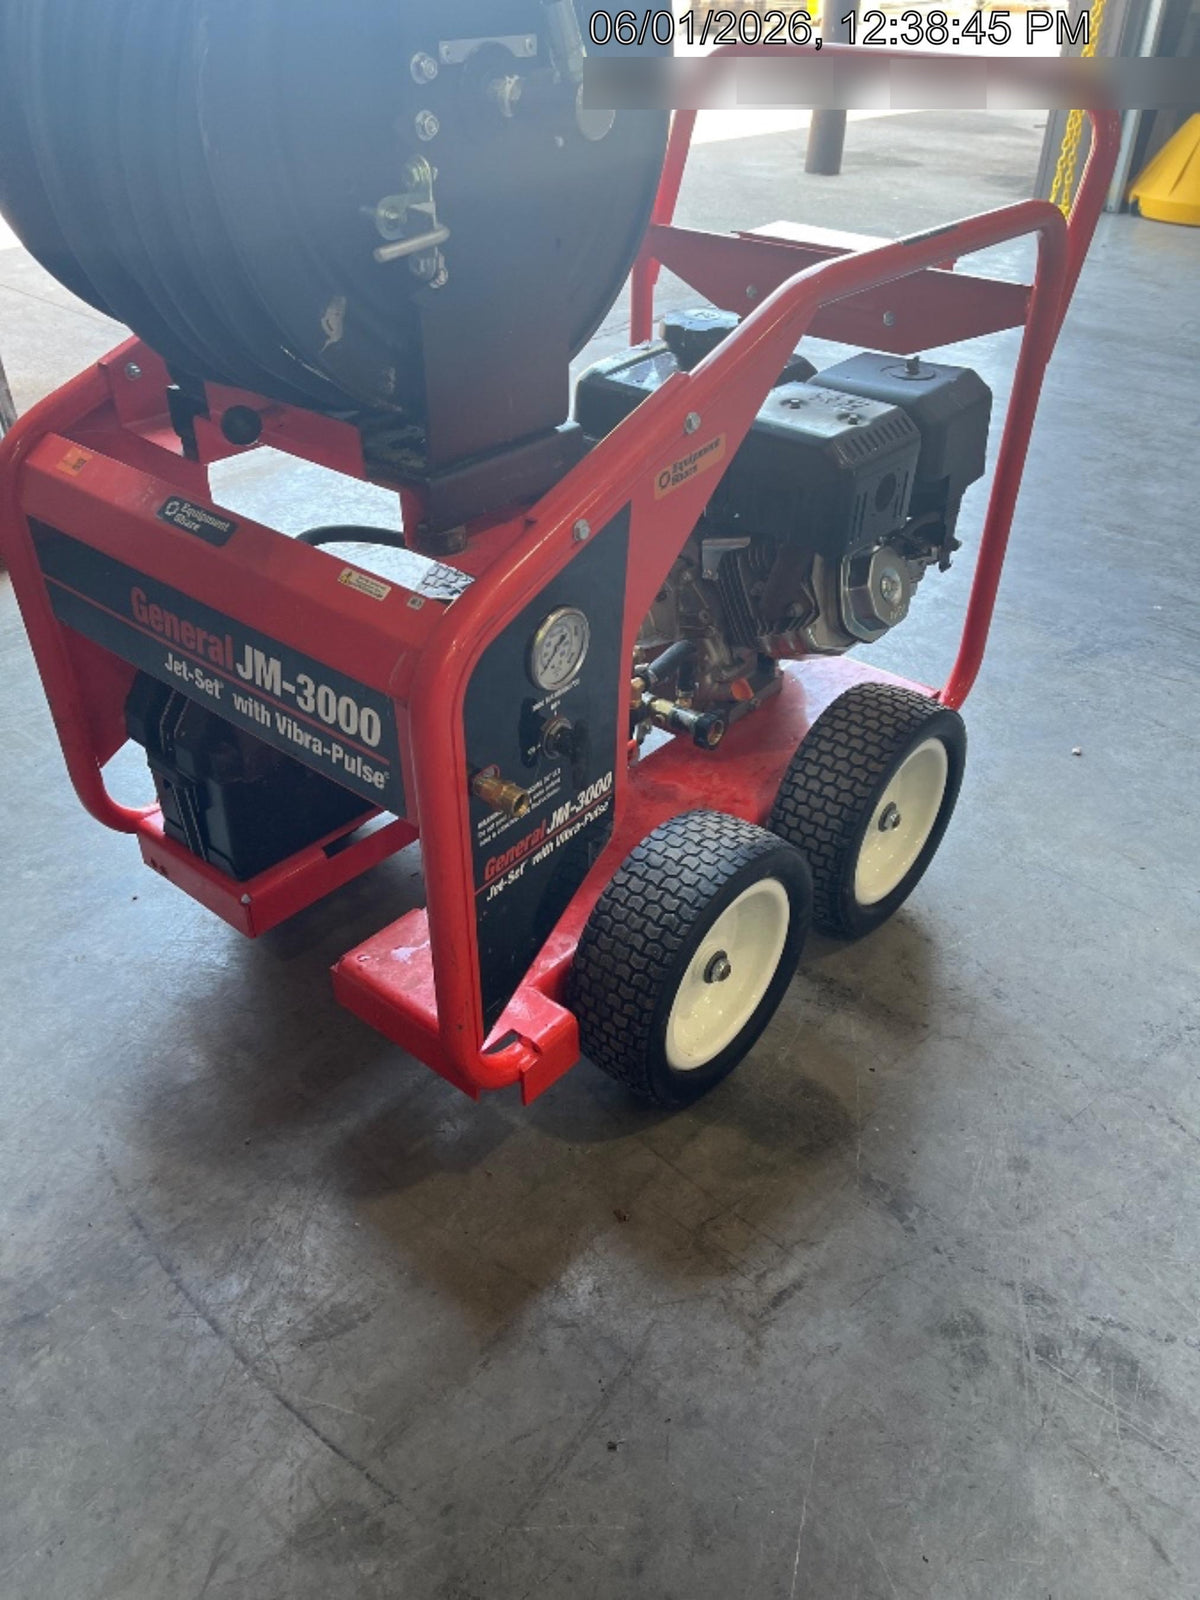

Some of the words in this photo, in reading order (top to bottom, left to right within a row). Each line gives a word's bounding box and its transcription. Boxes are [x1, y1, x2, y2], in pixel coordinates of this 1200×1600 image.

[180, 502, 231, 533] Equipment
[130, 586, 234, 671] General
[236, 644, 382, 748] JM-3000
[233, 692, 272, 728] with
[275, 711, 386, 789] Vibra-Pulse
[484, 818, 548, 882] General
[547, 770, 613, 834] JM-3000
[532, 841, 554, 866] with
